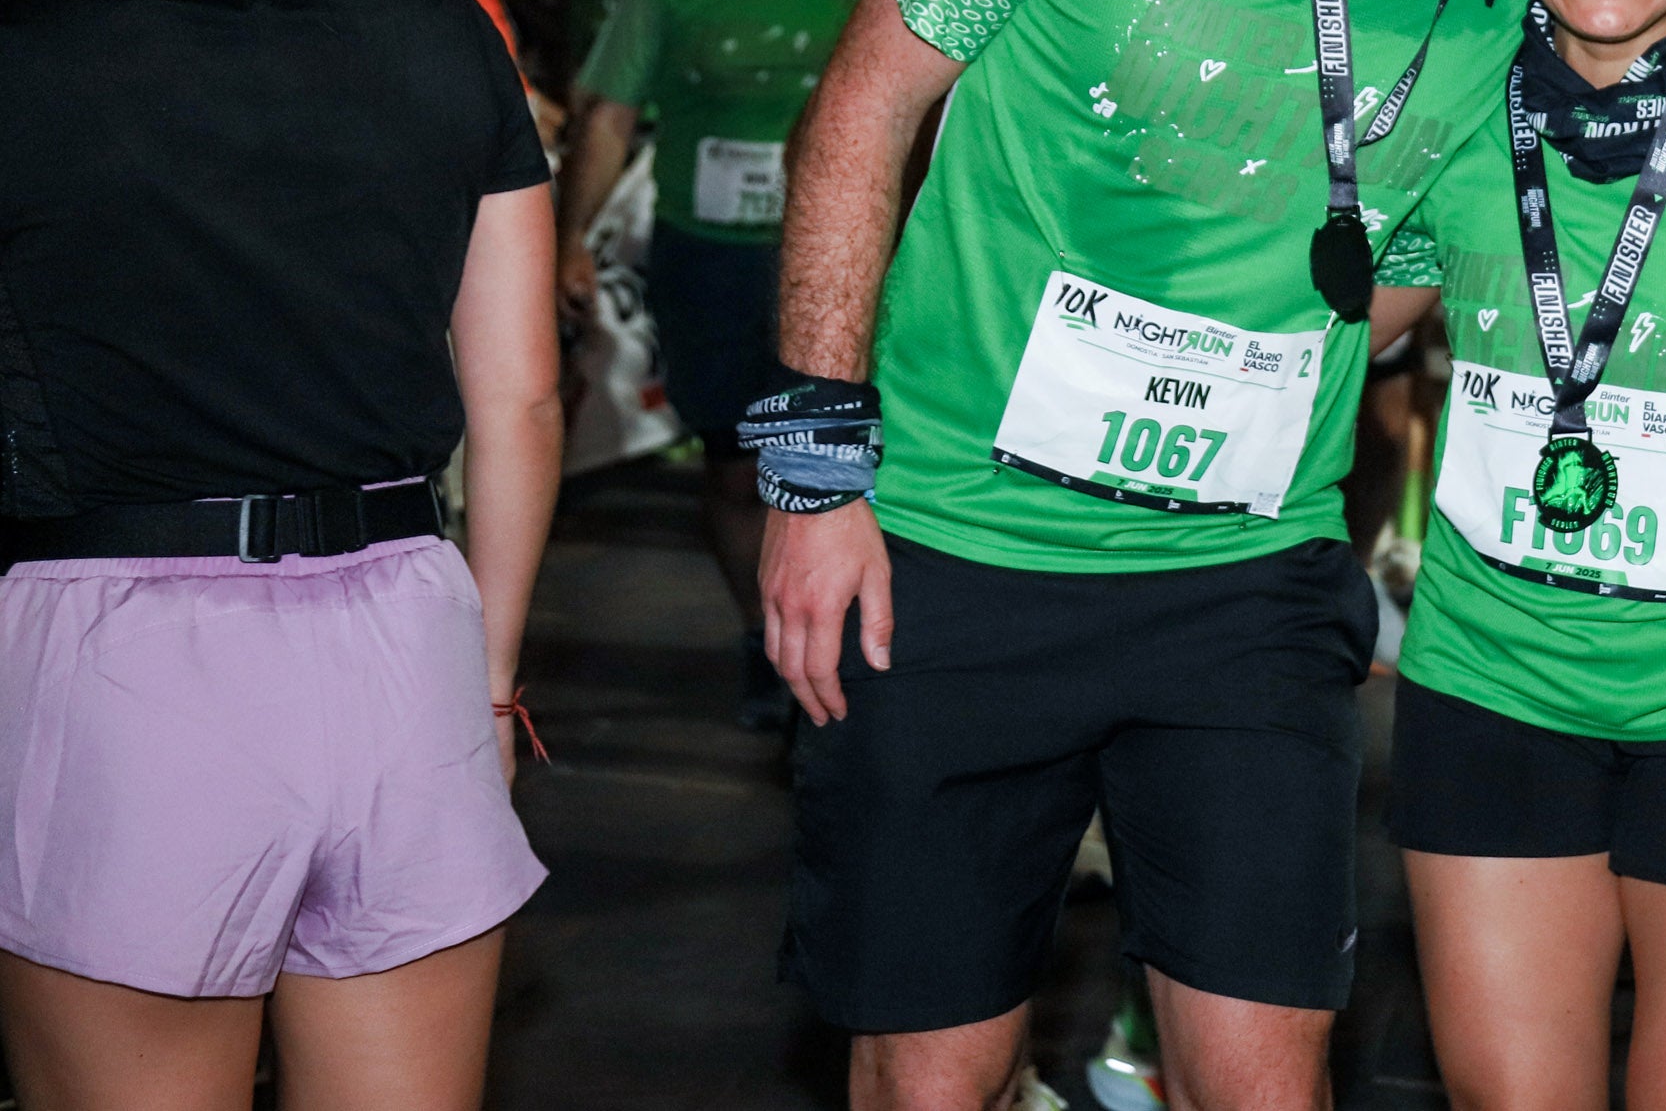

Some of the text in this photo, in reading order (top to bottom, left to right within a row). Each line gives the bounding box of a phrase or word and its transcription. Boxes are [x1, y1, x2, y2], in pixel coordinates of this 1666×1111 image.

[1601, 204, 1657, 305] FINISHER
[1054, 283, 1108, 327] 10K
[1205, 325, 1238, 340] Binter
[1531, 273, 1573, 369] FINISHER
[1245, 349, 1283, 363] DIARIO
[1248, 340, 1262, 351] EL
[1243, 359, 1279, 373] VASCO
[1297, 348, 1314, 378] 2
[1144, 376, 1211, 410] KEVIN
[1461, 370, 1501, 411] 10K
[1600, 391, 1631, 403] Binter
[1644, 401, 1657, 412] EL
[1097, 410, 1228, 482] 1067
[1545, 562, 1601, 579] 7 JUN 2025
